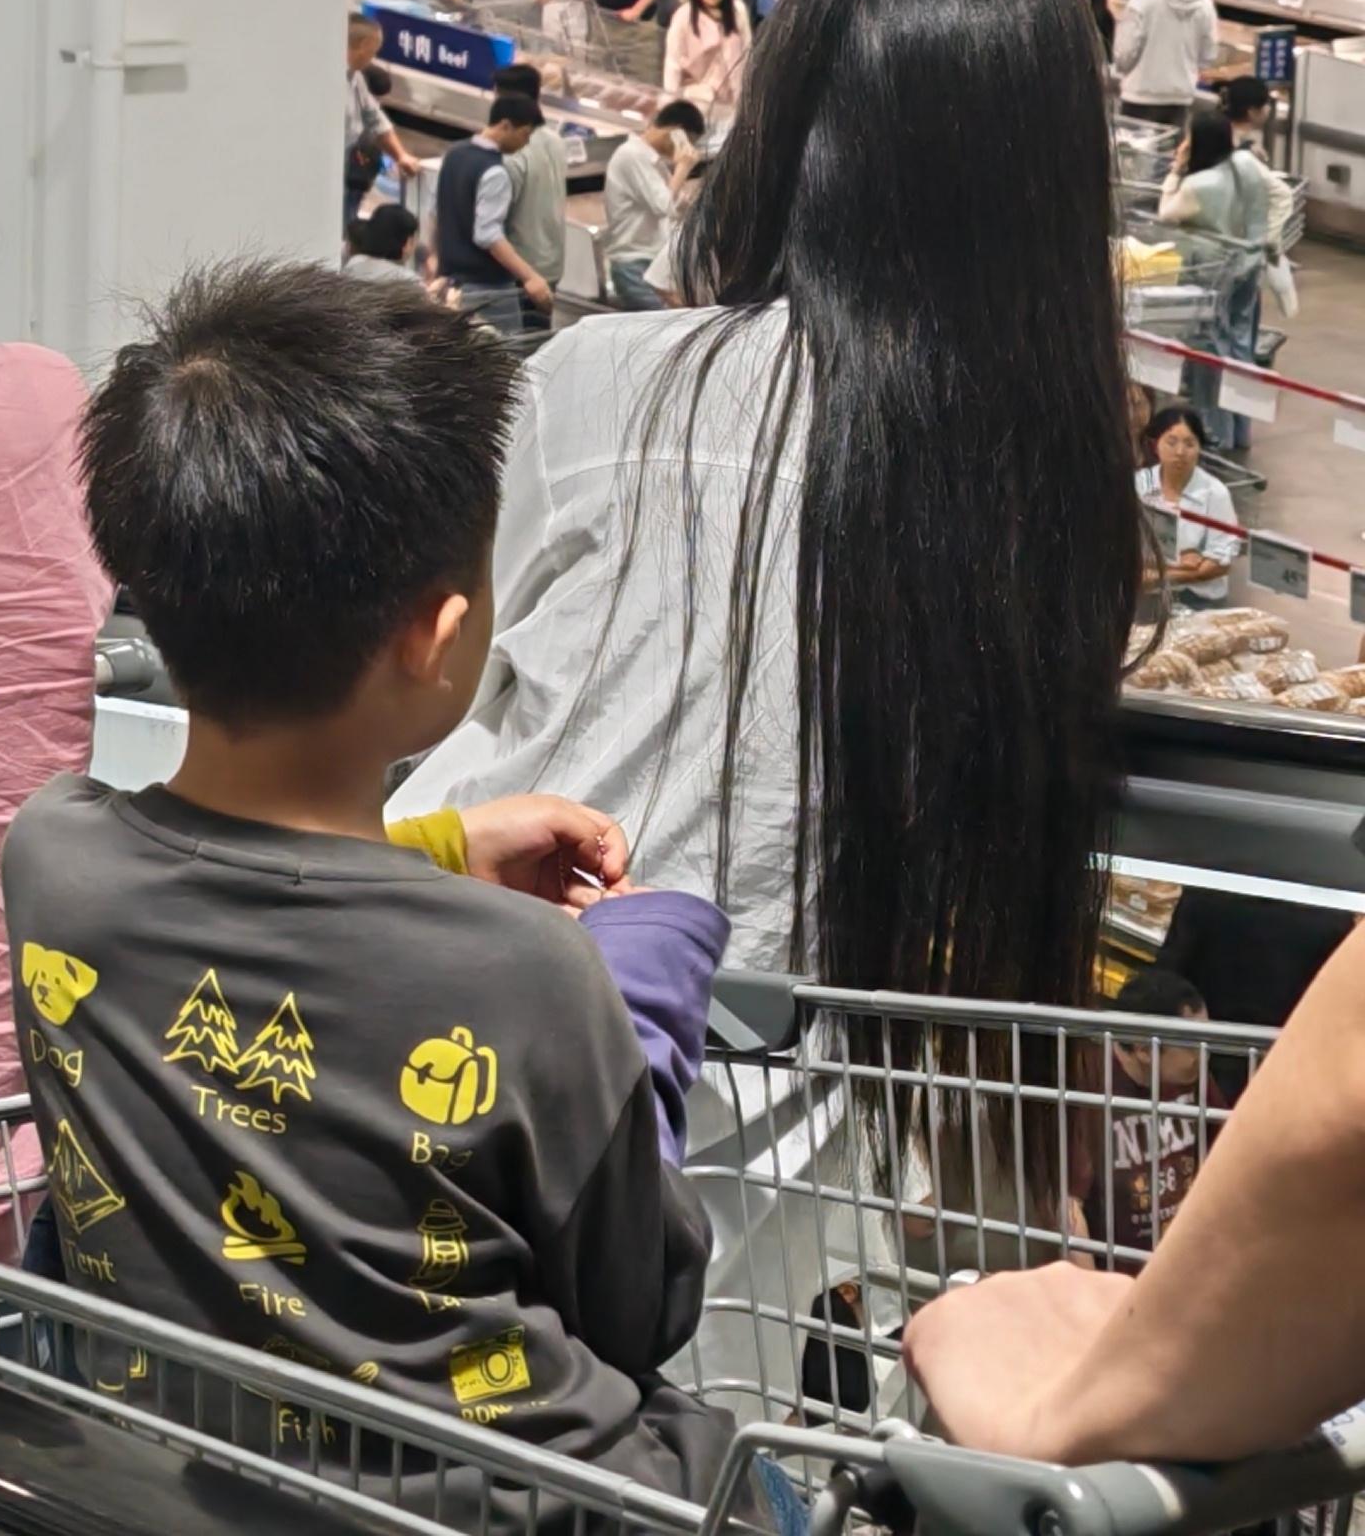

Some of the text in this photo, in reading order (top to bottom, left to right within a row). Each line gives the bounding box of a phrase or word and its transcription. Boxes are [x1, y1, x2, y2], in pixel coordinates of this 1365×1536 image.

[398, 30, 431, 64] 牛肉
[30, 1029, 83, 1088] Dog
[191, 1085, 287, 1134] Trees
[65, 1238, 117, 1283] Tent
[239, 1283, 307, 1316] Fire
